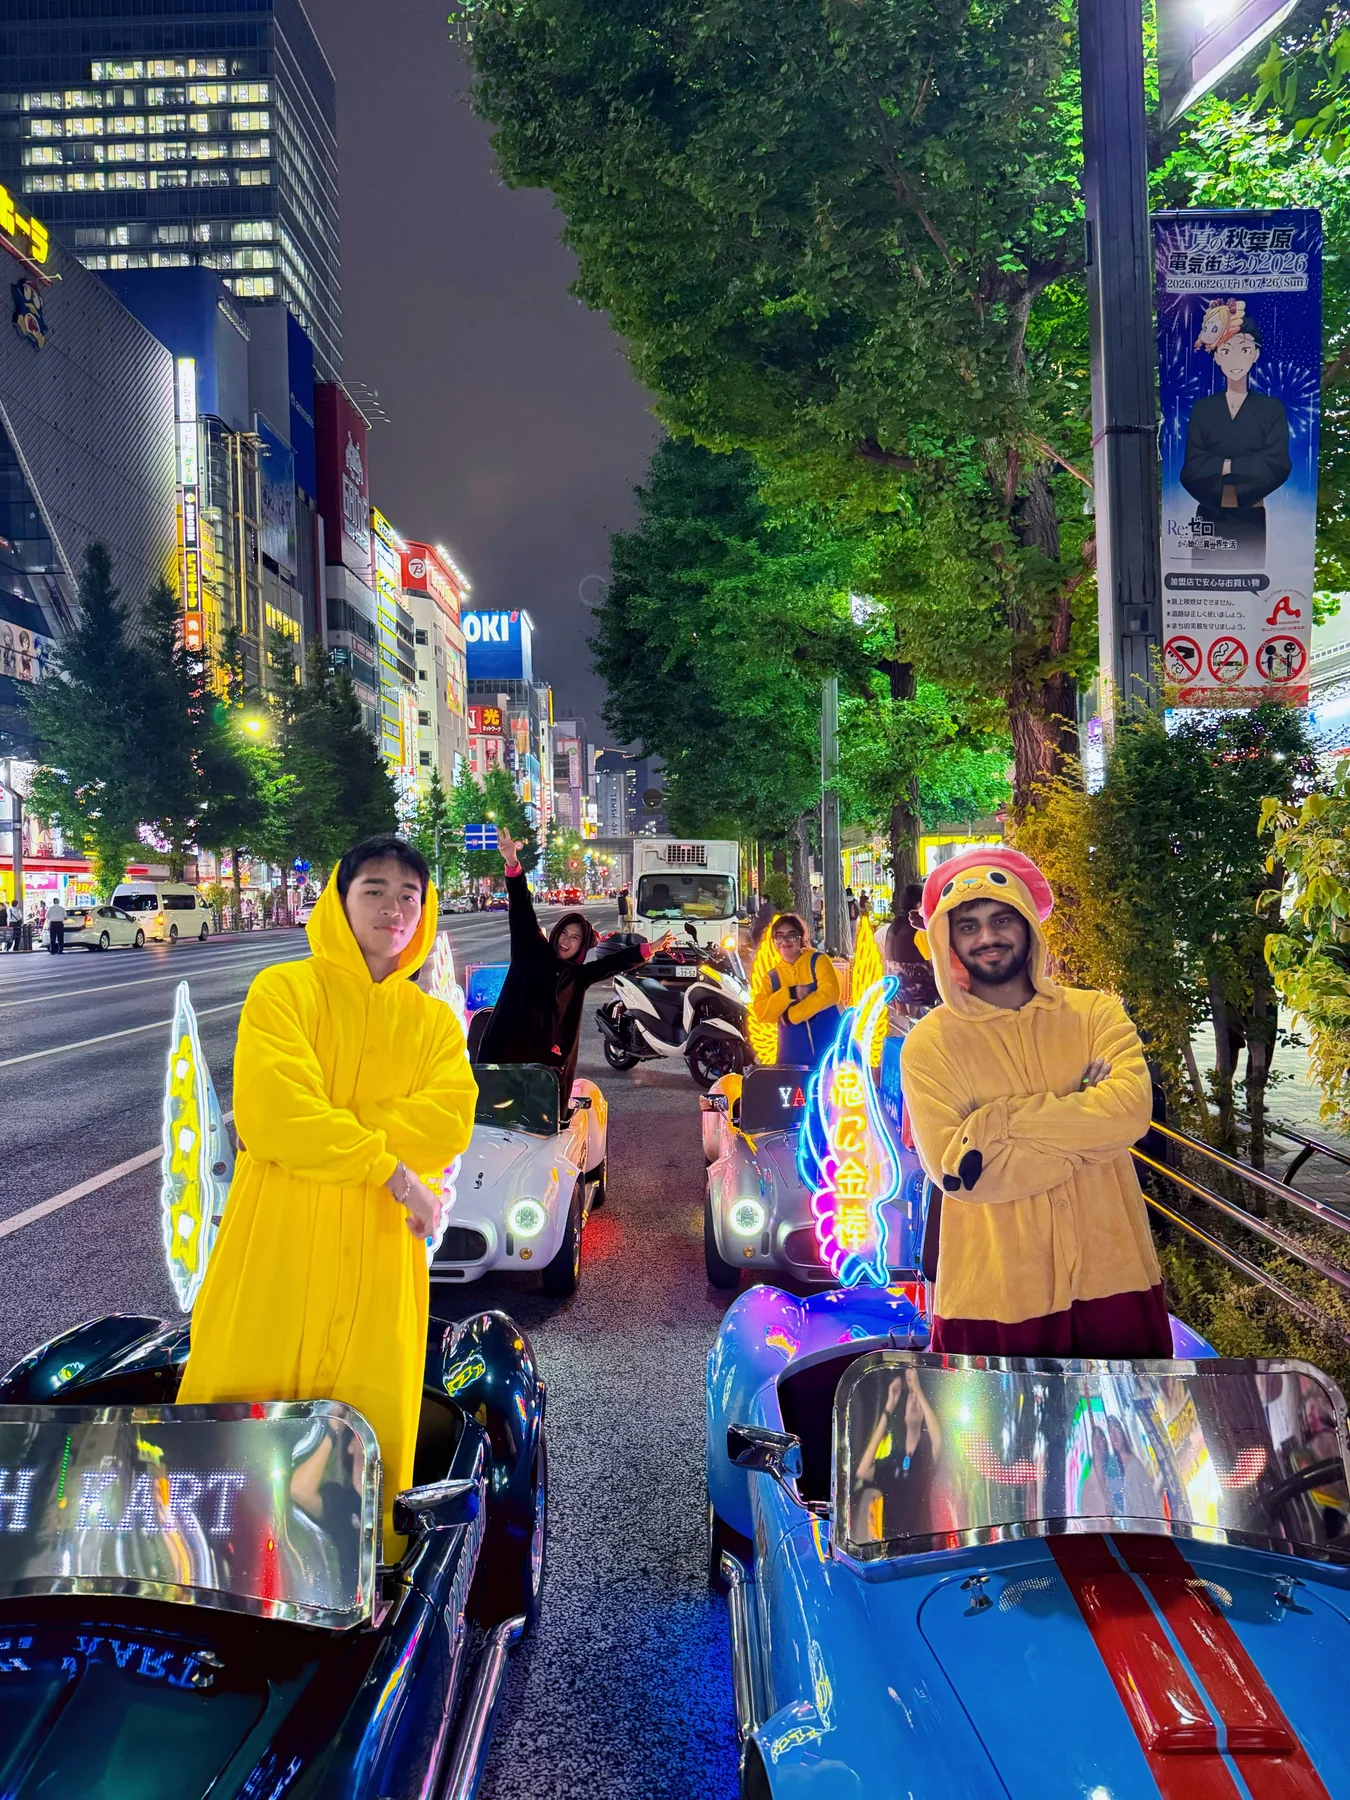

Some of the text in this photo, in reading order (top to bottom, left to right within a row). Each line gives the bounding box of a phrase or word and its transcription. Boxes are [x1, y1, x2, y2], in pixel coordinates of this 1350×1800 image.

[1189, 227, 1294, 255] 夏の秋葉原
[1169, 252, 1308, 274] 電気街まつり2026
[1167, 516, 1214, 536] Re:ゼロ
[1178, 539, 1237, 551] から始める異世界生活
[1170, 577, 1260, 588] 加盟店で安心なお買い物
[483, 708, 500, 725] 光
[831, 1062, 870, 1251] 鬼に金棒
[75, 1470, 245, 1535] KART
